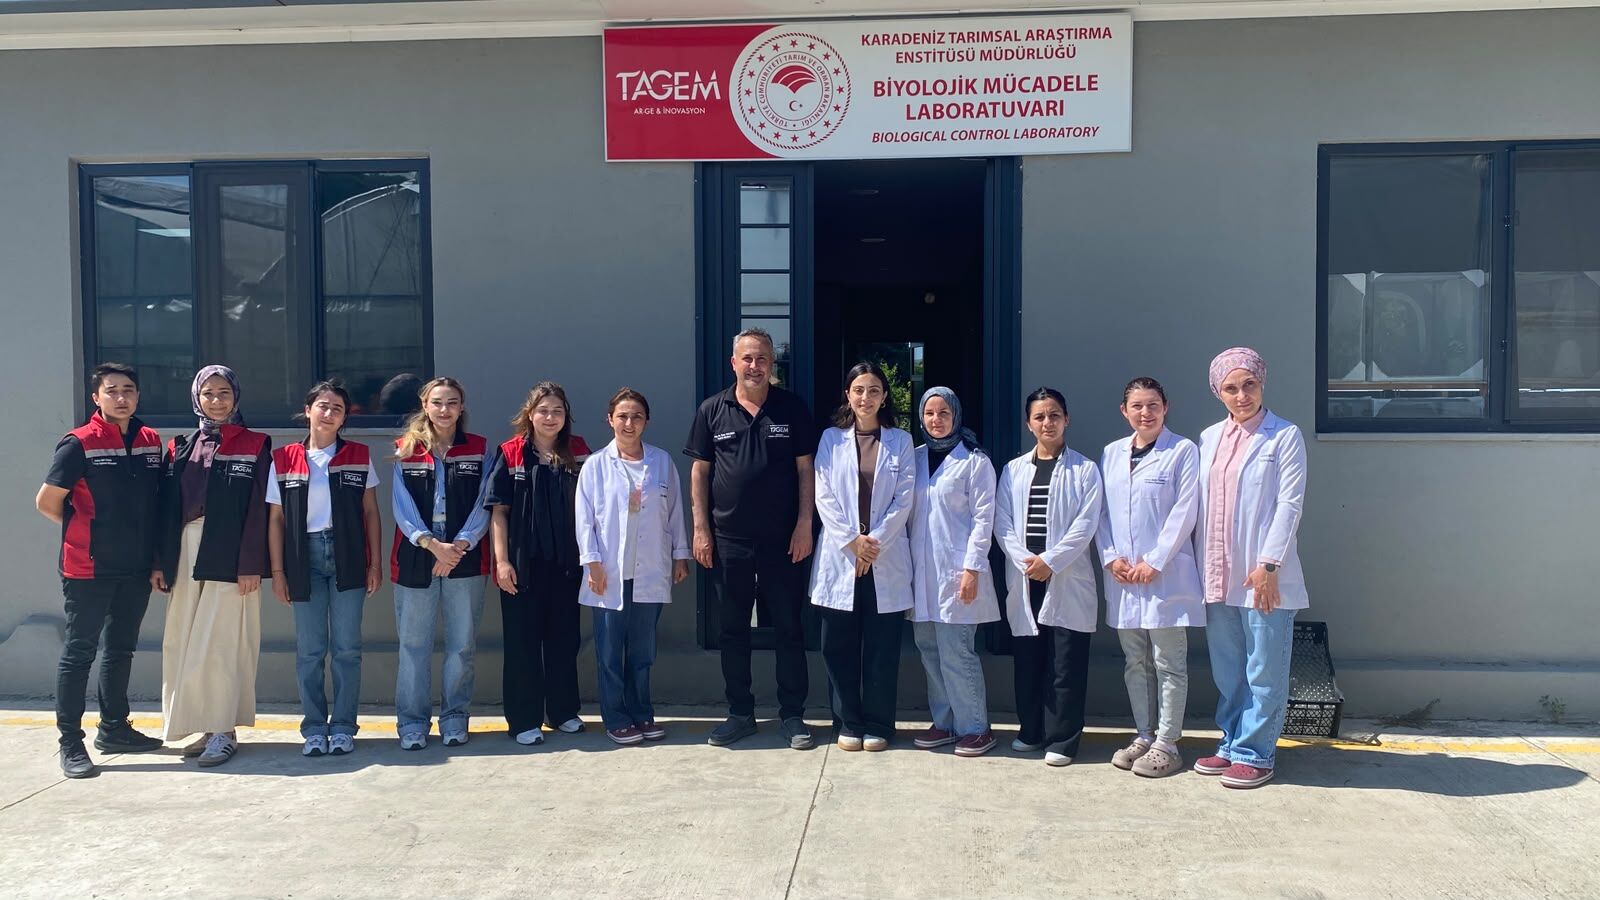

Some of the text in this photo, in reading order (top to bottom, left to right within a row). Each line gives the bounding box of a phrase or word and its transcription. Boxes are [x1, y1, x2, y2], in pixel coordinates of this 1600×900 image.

[861, 26, 1113, 46] KARADENİZ TARIMSAL ARAŞTIRMA
[895, 43, 1077, 64] ENSTİTÜSÜ MÜDÜRLÜĞÜ
[616, 70, 721, 100] TAGEM
[758, 58, 783, 104] CUMHURİYETİ
[783, 54, 807, 62] TARIM
[808, 58, 817, 67] VE
[816, 65, 830, 92] ORMAN
[873, 72, 1099, 98] BİYOLOJİK MÜCADELE
[662, 106, 706, 115] İNOVASYON
[906, 99, 1064, 121] LABORATUVARI
[871, 126, 1100, 144] BIOLOGICAL CONTROL LABORATORY
